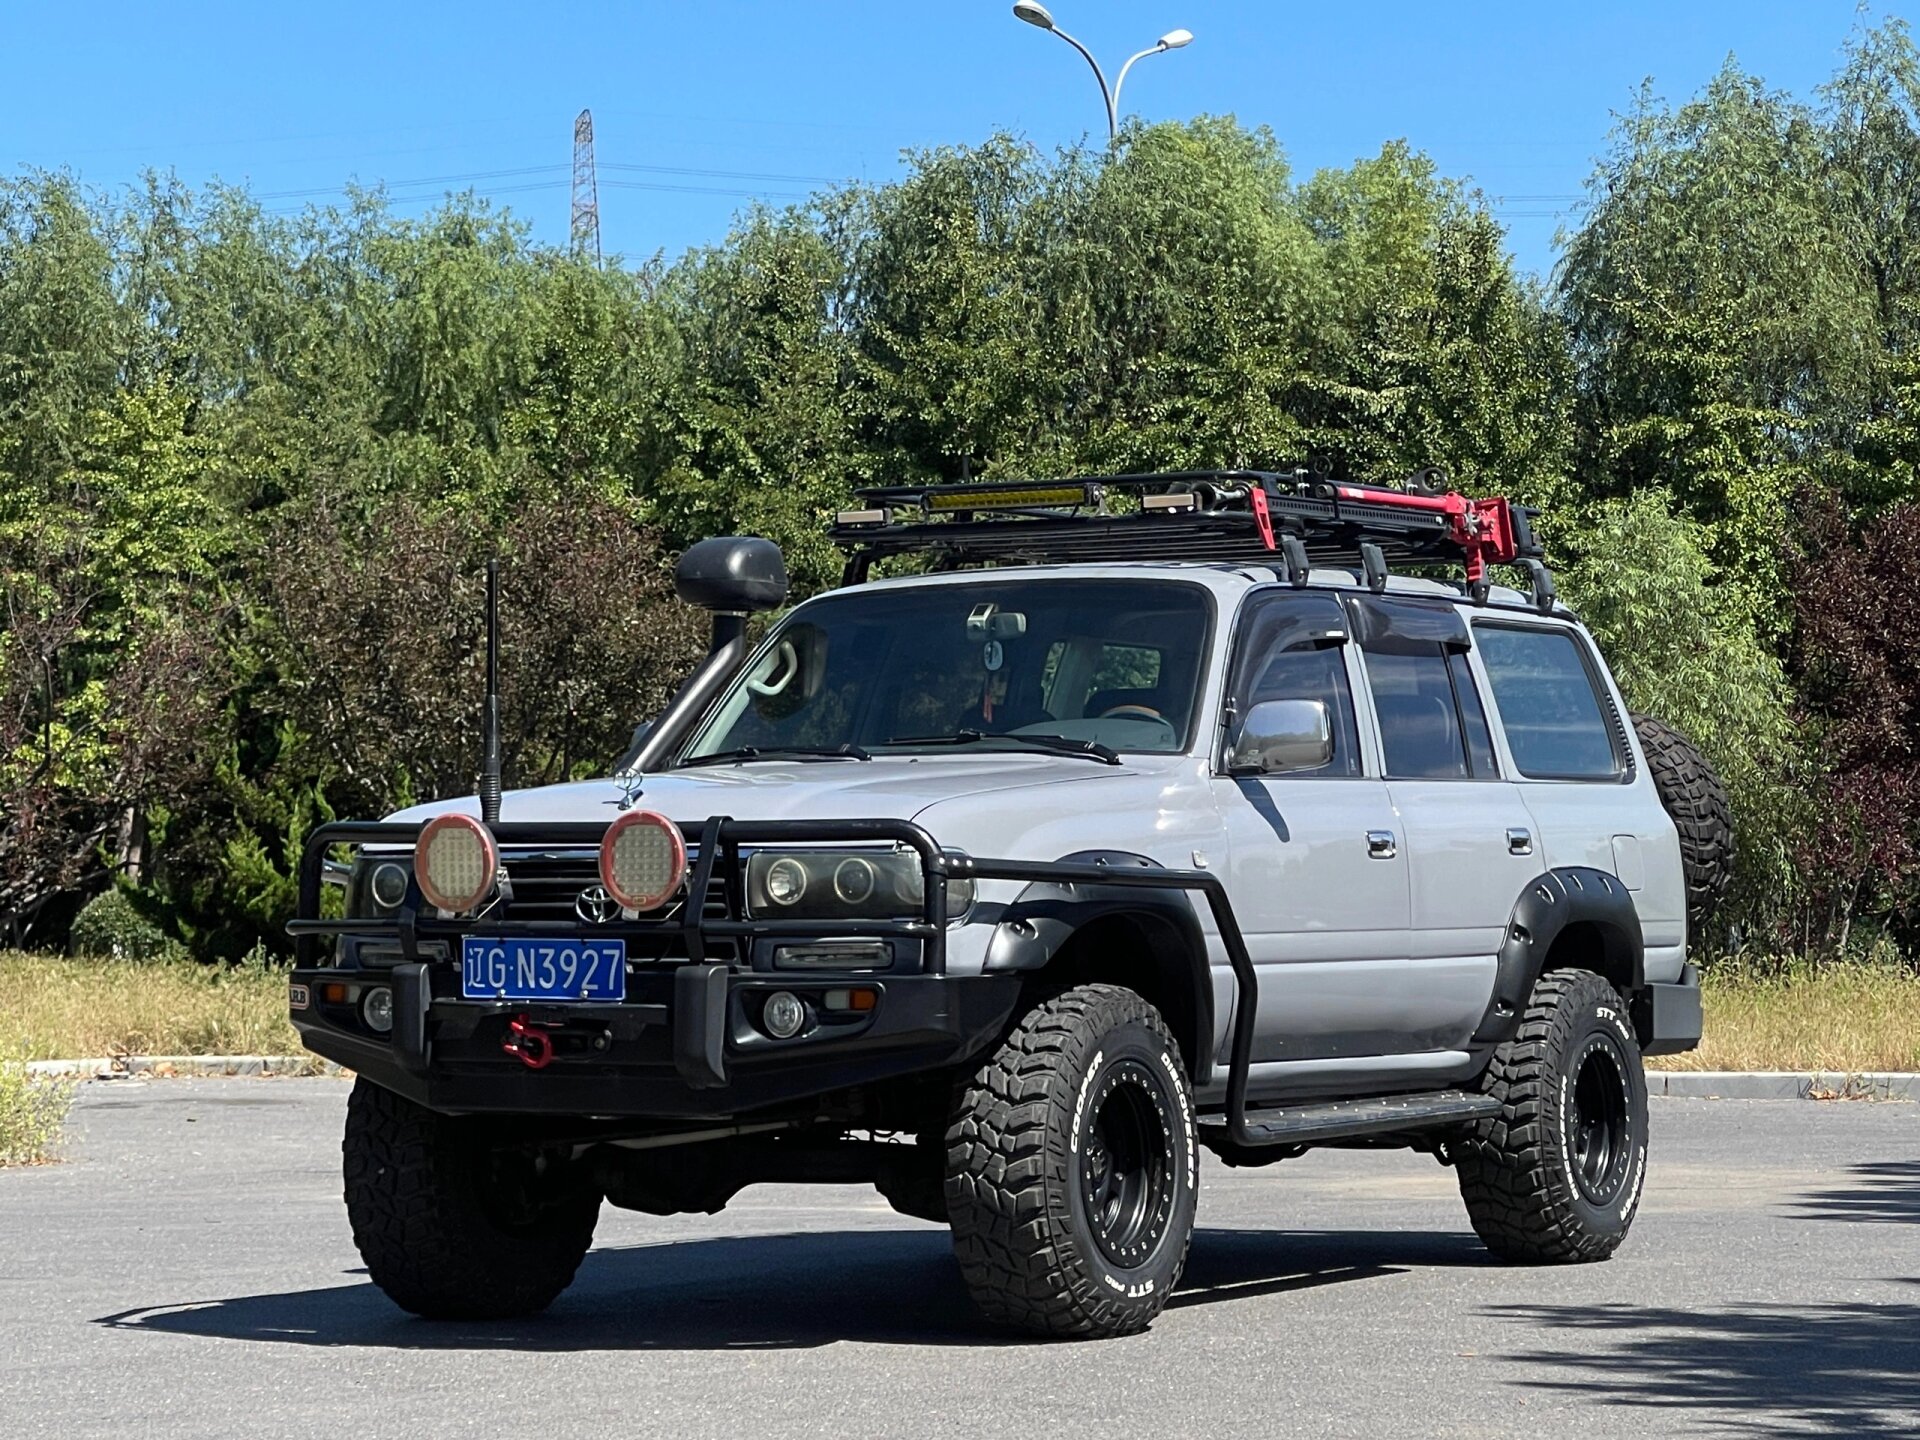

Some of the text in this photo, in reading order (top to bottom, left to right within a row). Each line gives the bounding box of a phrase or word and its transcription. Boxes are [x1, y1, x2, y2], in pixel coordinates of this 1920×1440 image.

[468, 948, 620, 990] 辽G·N3927
[1596, 1007, 1616, 1021] STT
[1070, 1050, 1103, 1153] COOPER
[1160, 1052, 1195, 1189] DISCOVERER
[1620, 1145, 1644, 1221] COOPER
[1104, 1274, 1155, 1298] STT PRO
